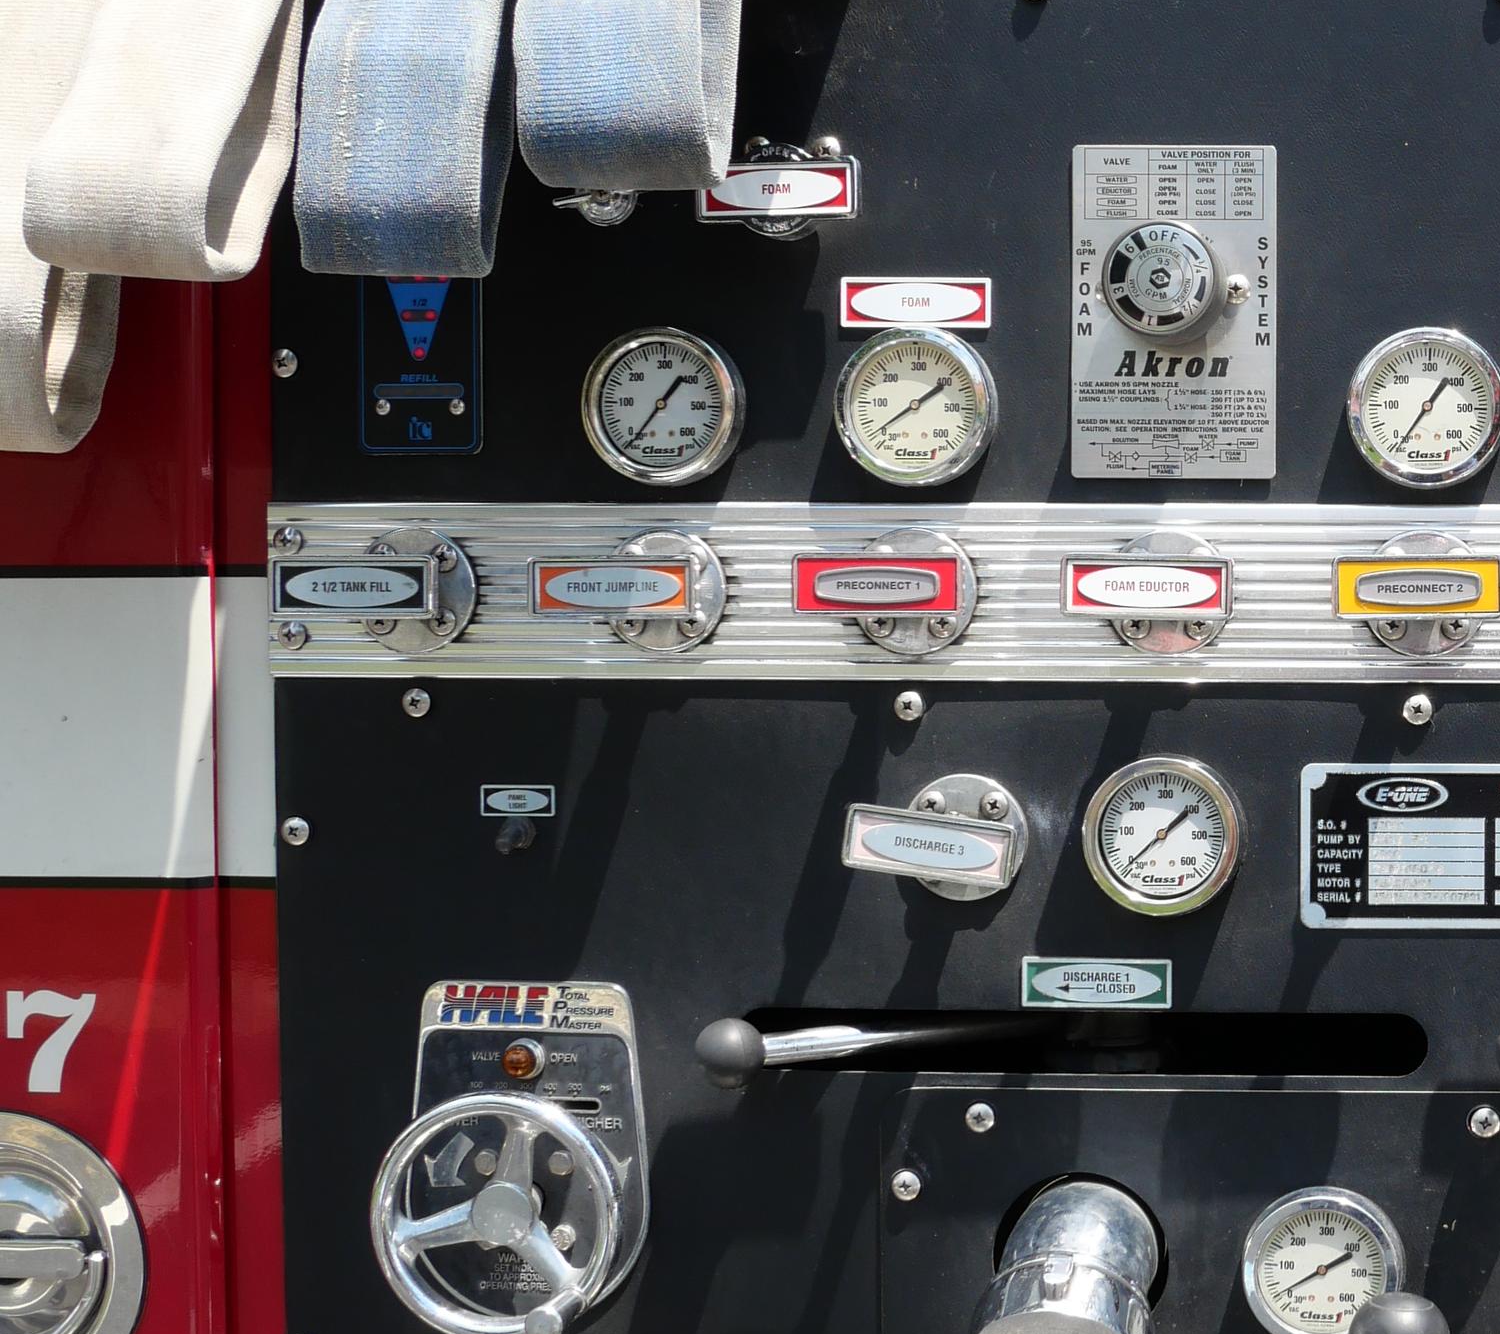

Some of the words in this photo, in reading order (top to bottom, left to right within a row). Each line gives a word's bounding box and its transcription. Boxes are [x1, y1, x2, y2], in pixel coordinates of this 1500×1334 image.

[1161, 150, 1188, 159] VALVE
[1190, 150, 1231, 159] POSITION
[1233, 151, 1251, 159] FOR
[1103, 158, 1131, 166] VALVE
[761, 184, 791, 195] FOAM
[1149, 230, 1180, 243] OFF
[1076, 248, 1097, 256] GPM
[901, 297, 930, 308] FOAM
[1114, 350, 1230, 378] Akron
[312, 581, 320, 593] 2
[322, 581, 338, 593] 1/2
[339, 581, 367, 593] TANK
[370, 582, 392, 593] FILL
[567, 581, 601, 593] FRONT
[605, 581, 659, 593] JUMPLINE
[836, 581, 911, 591] PRECONNECT
[916, 581, 921, 590] 1
[1104, 581, 1136, 592] FOAM
[1139, 581, 1190, 593] EDUCTOR
[1377, 583, 1452, 594] PRECONNECT
[1456, 582, 1464, 593] 2
[1377, 787, 1429, 802] E-ONE
[894, 836, 955, 854] DISCHARGE
[958, 844, 965, 855] 3
[1317, 835, 1344, 845] PUMP
[1348, 835, 1360, 845] BY
[1317, 849, 1363, 859] CAPACITY
[1317, 864, 1341, 873] TYPE
[1063, 972, 1120, 982] DISCHARGE
[1124, 972, 1130, 982] 1
[1096, 984, 1136, 994] CLOSED
[440, 985, 549, 1024] HALE
[6, 990, 97, 1093] 7
[471, 1052, 500, 1062] VALVE
[550, 1053, 577, 1064] OPEN
